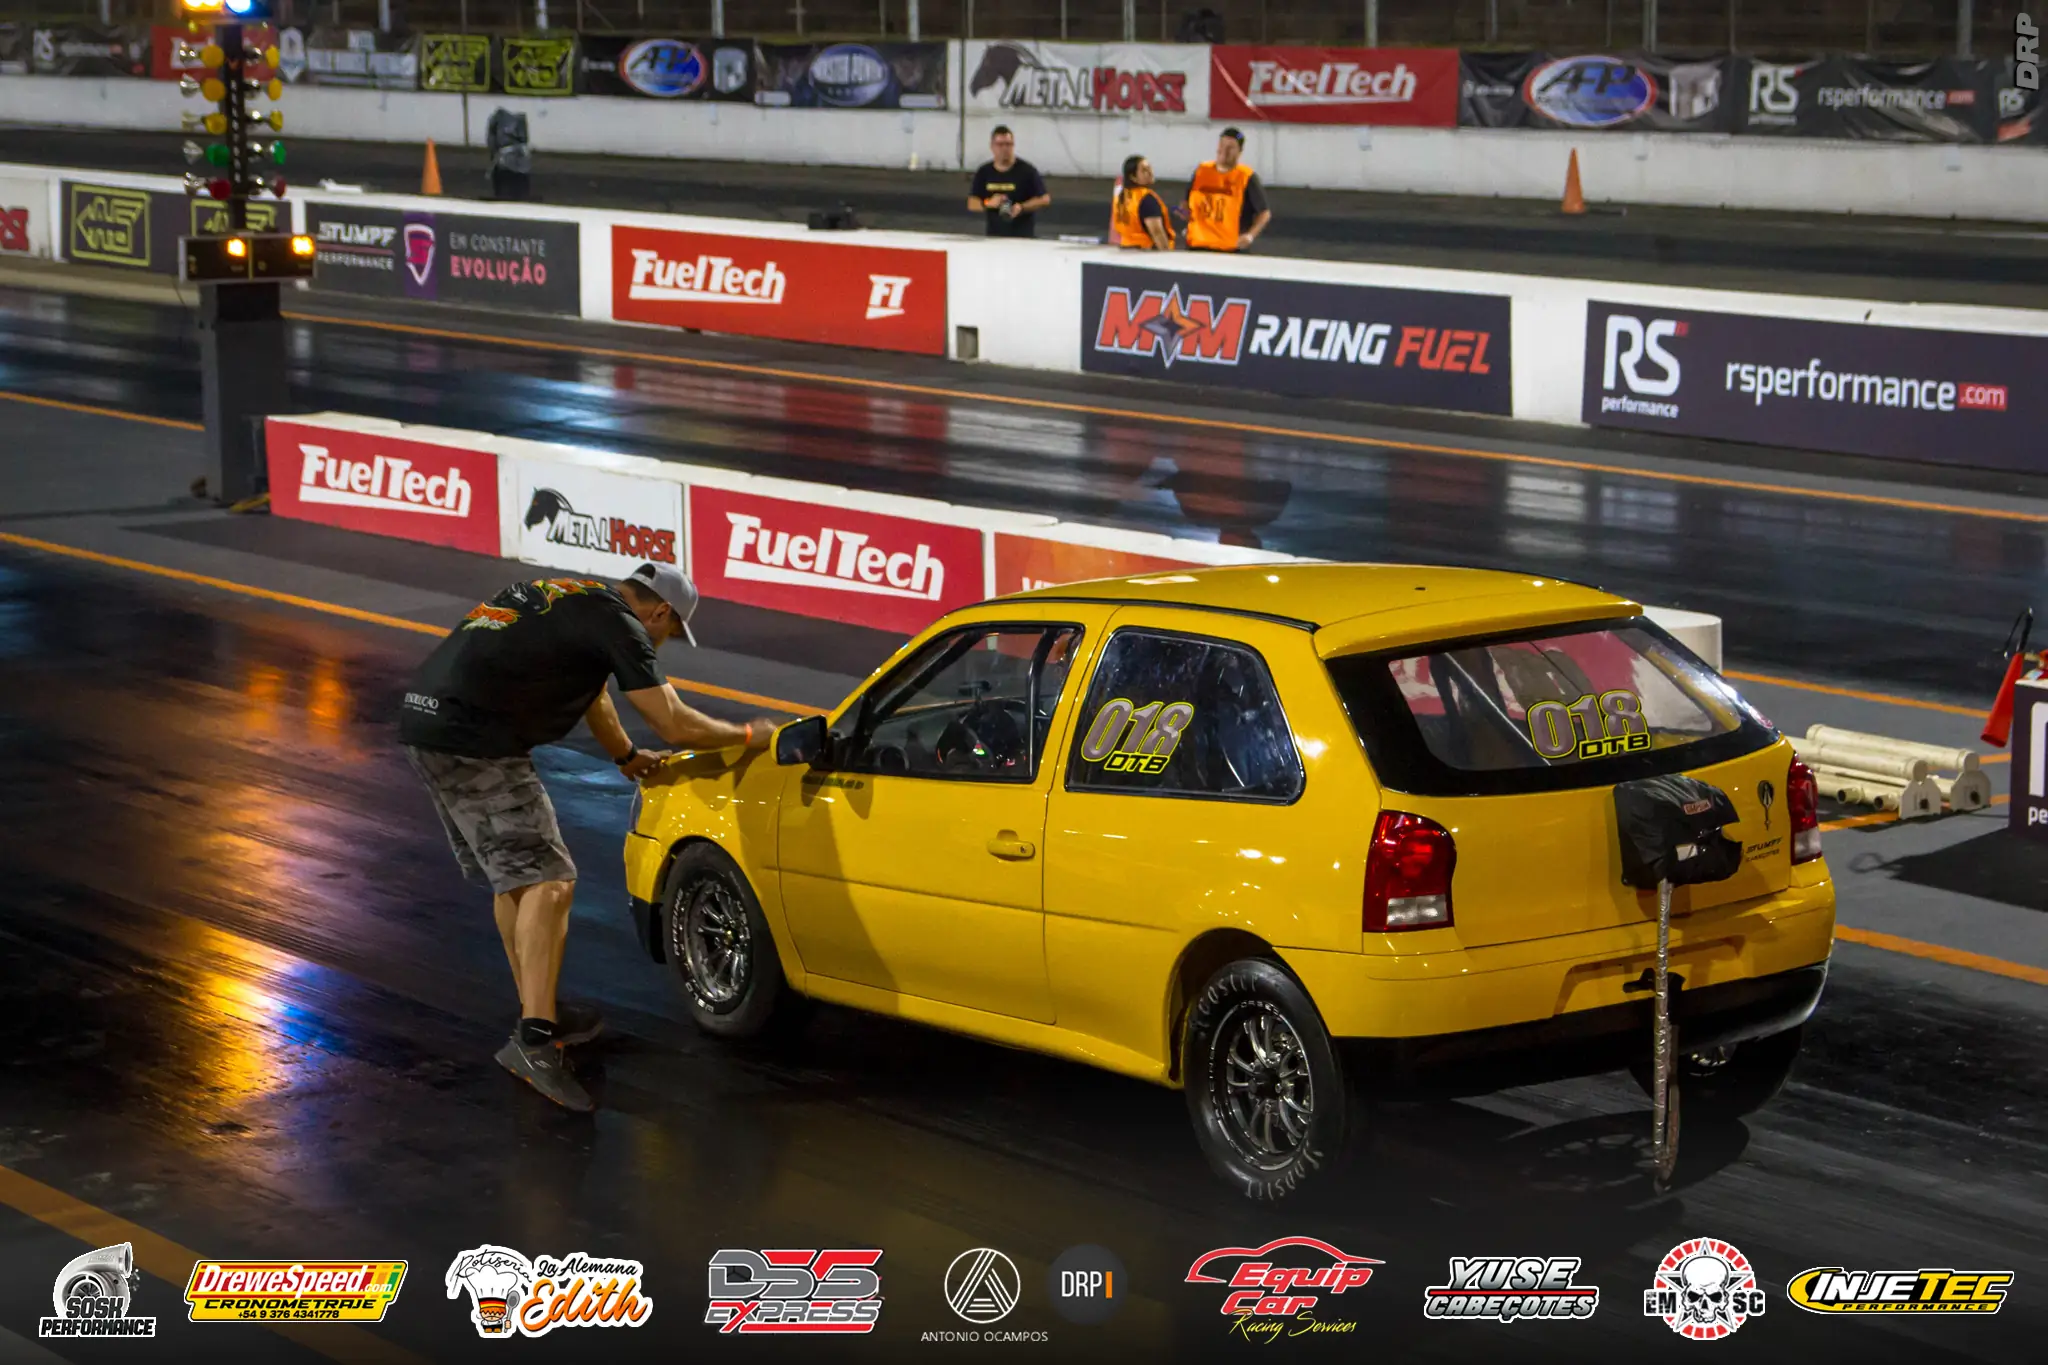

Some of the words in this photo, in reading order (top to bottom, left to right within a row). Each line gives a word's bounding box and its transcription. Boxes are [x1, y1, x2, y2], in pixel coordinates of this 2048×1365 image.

[1001, 64, 1186, 112] METALHORSE
[1248, 60, 1417, 101] FuelTech
[317, 221, 398, 247] STUMPF
[317, 250, 395, 271] PERFORMANCE
[449, 231, 468, 250] EM
[469, 234, 546, 258] CONSTANTE
[450, 255, 547, 286] EVOLUÇÃO
[630, 248, 786, 304] FuelTech
[1249, 313, 1392, 366] RACING
[1394, 325, 1491, 375] FUEL
[1602, 313, 1684, 397] RS
[1601, 394, 1679, 419] performance
[299, 443, 472, 518] FuelTech
[546, 509, 676, 564] METALHORSE
[725, 511, 945, 601] FuelTech
[1081, 697, 1195, 762] 018
[1528, 690, 1648, 759] 018
